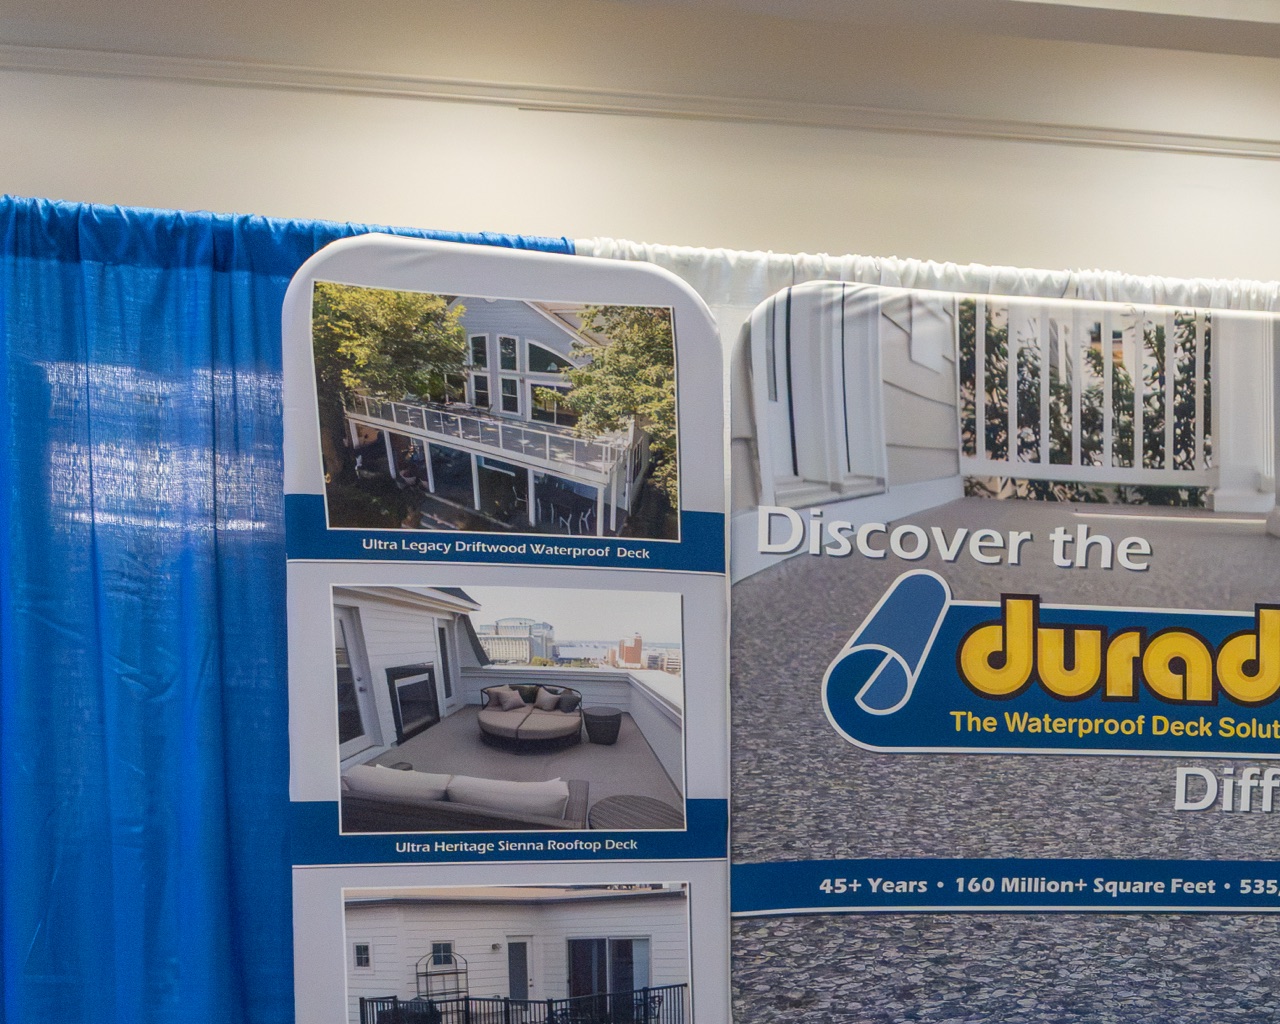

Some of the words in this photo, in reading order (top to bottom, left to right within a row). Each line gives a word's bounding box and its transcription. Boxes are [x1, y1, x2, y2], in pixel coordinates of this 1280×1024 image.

[362, 538, 398, 550] Ultra
[401, 539, 452, 554] Legacy
[455, 540, 527, 554] Driftwood
[530, 543, 611, 559] Waterproof
[616, 547, 650, 559] Deck
[757, 505, 1032, 565] Discover
[1049, 524, 1153, 571] the
[949, 711, 998, 733] The
[1004, 711, 1146, 738] Waterproof
[1152, 714, 1212, 737] Deck
[396, 842, 430, 853] Ultra
[434, 841, 495, 854] Heritage
[498, 840, 544, 852] Sienna
[547, 839, 602, 852] Rooftop
[605, 839, 638, 850] Deck
[819, 877, 862, 894] 45+
[867, 877, 928, 894] Years
[955, 877, 995, 893] 160
[1001, 876, 1088, 893] Million+
[1093, 877, 1165, 897] Square
[1171, 878, 1216, 894] Feet
